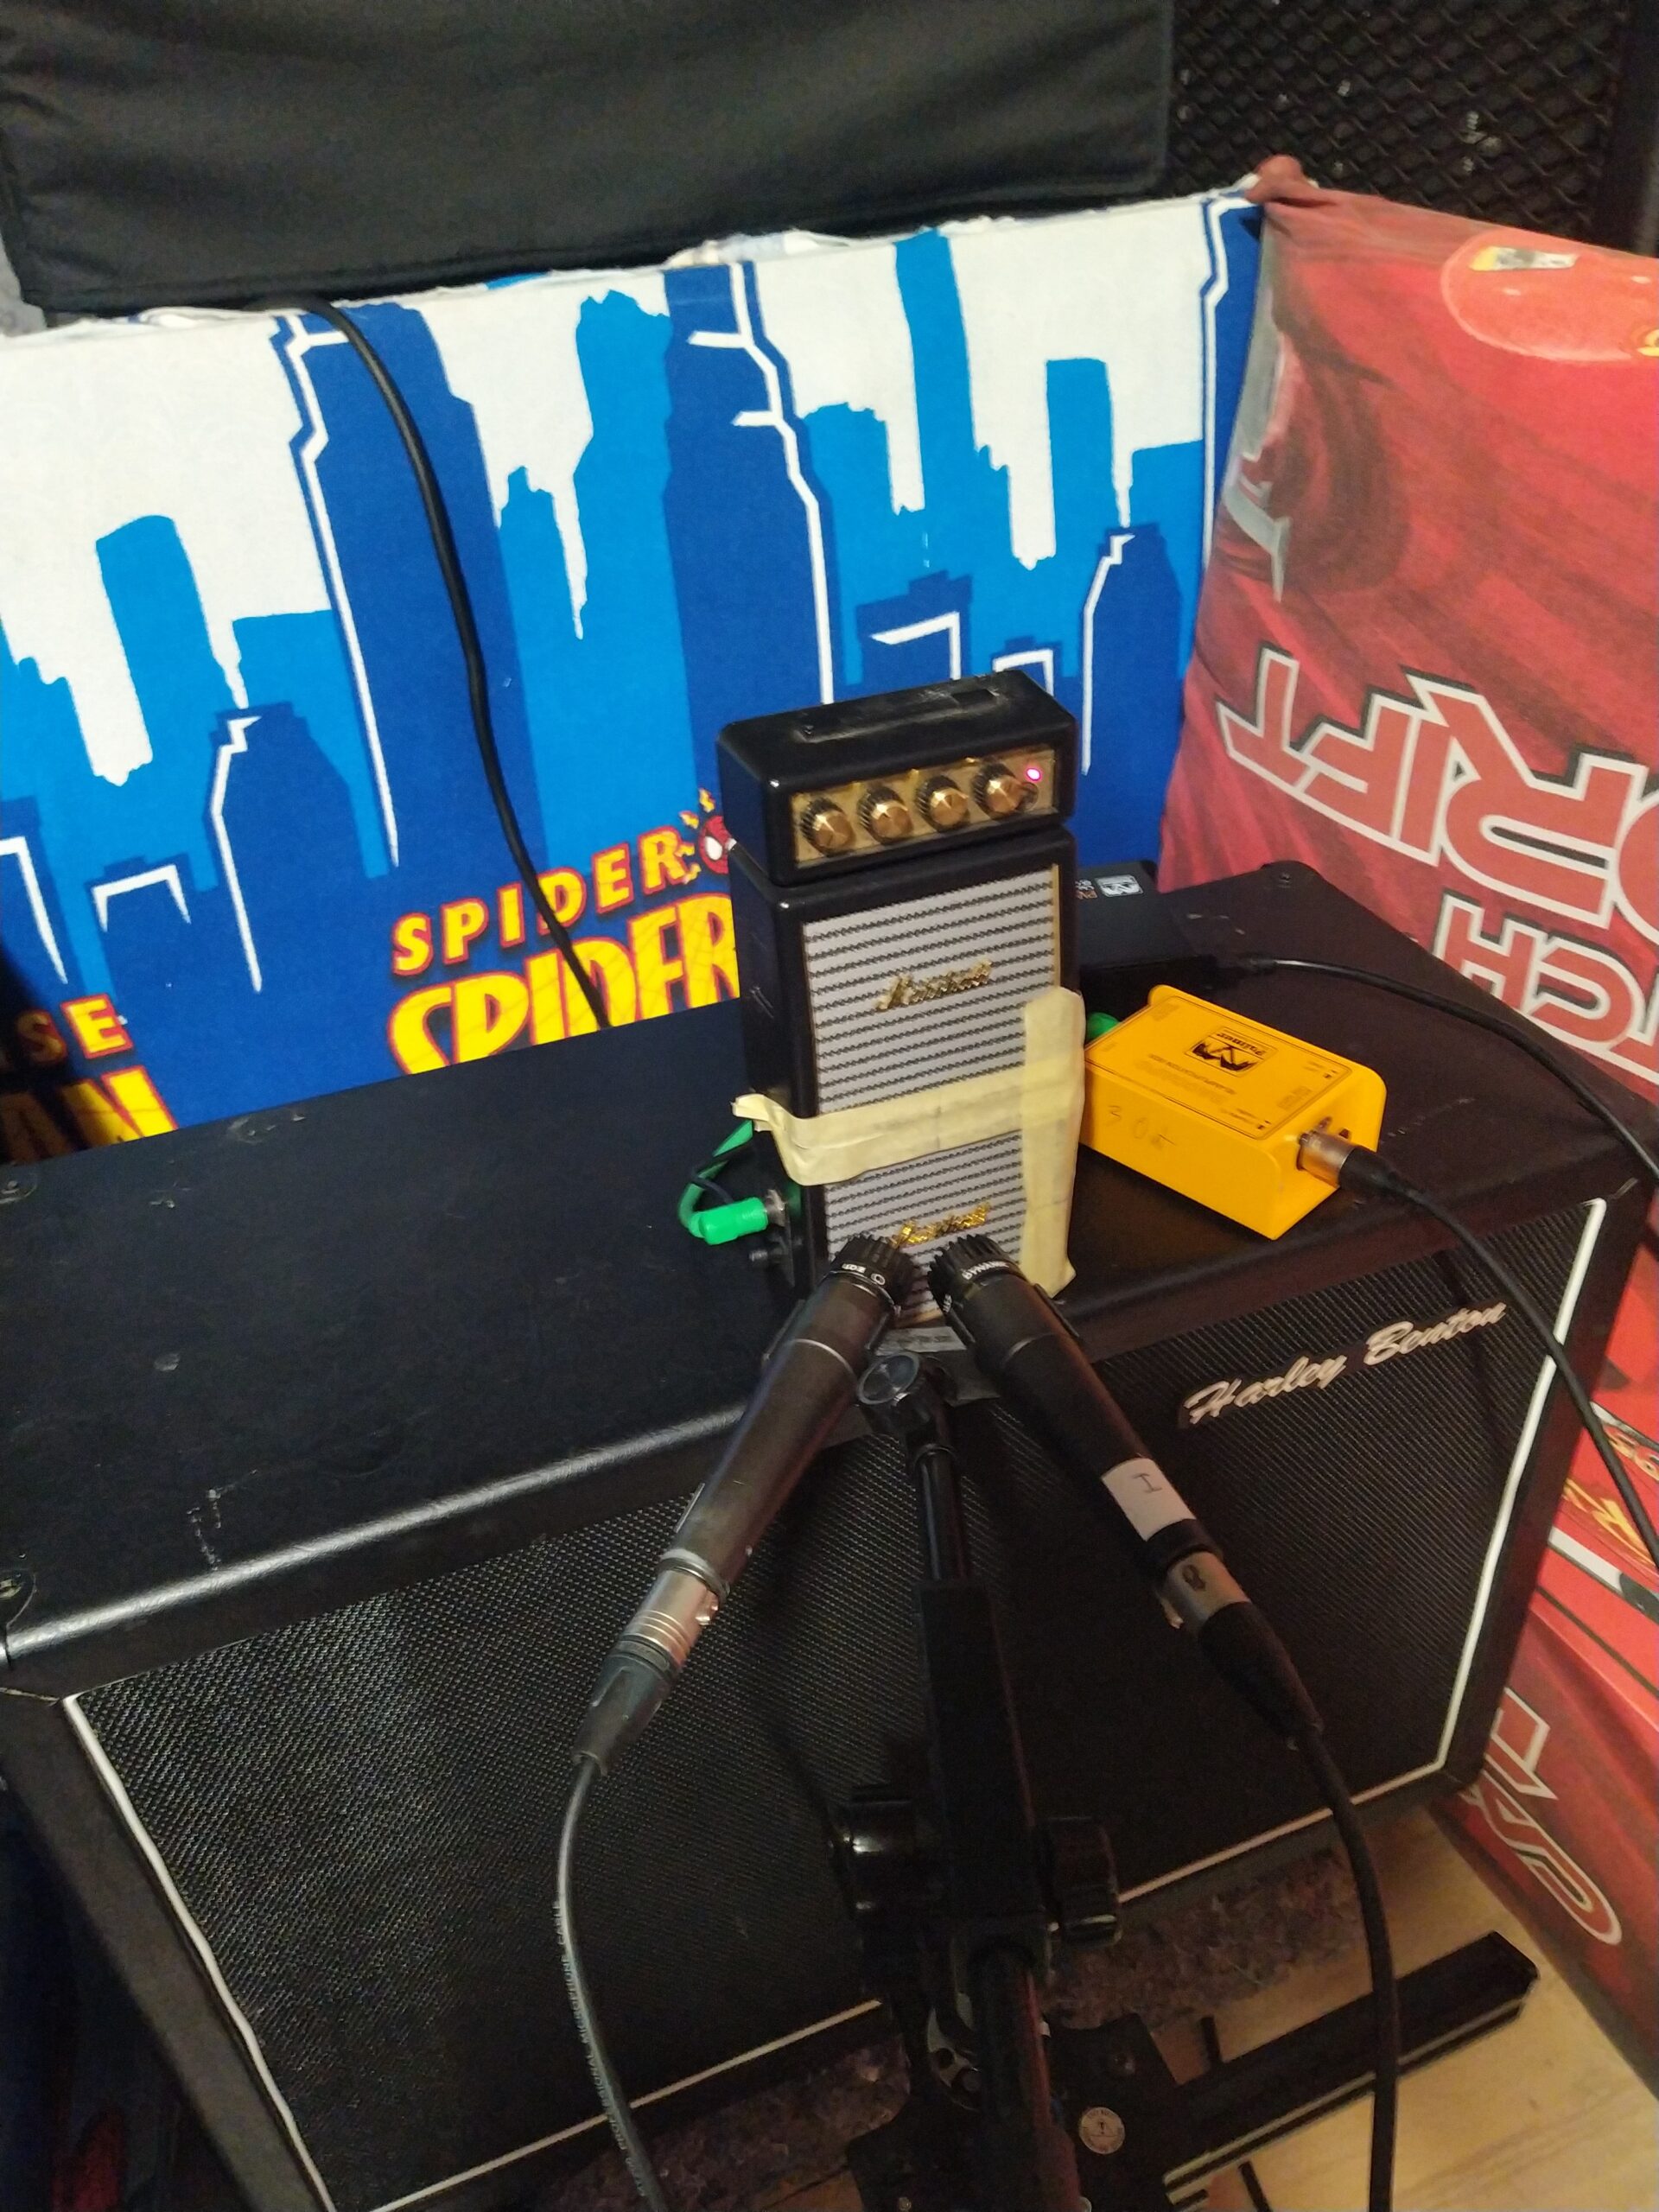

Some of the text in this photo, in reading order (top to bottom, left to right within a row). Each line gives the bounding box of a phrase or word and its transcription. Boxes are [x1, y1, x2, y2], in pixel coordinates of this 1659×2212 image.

[1216, 645, 1659, 945] RIFT
[391, 824, 693, 978] SPIDER
[1184, 1301, 1507, 1425] Harley Benton
